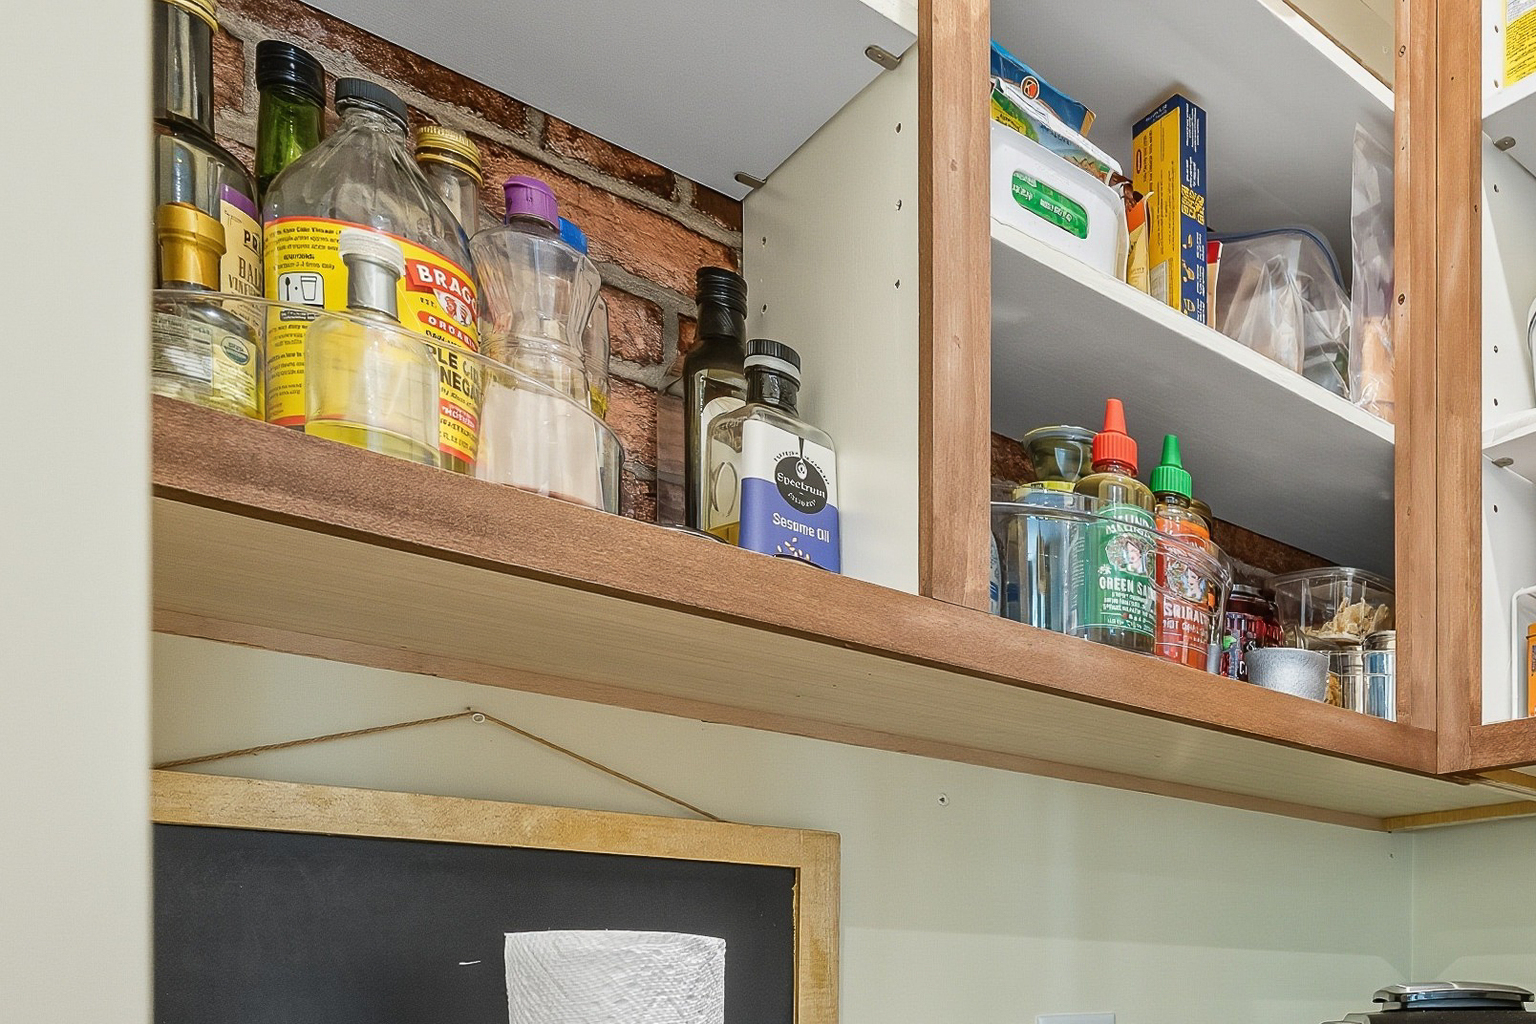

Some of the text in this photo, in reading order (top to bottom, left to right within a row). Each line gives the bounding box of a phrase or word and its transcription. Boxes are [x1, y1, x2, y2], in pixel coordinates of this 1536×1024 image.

[777, 472, 826, 499] Spectrum
[772, 512, 830, 543] Sesame Oil
